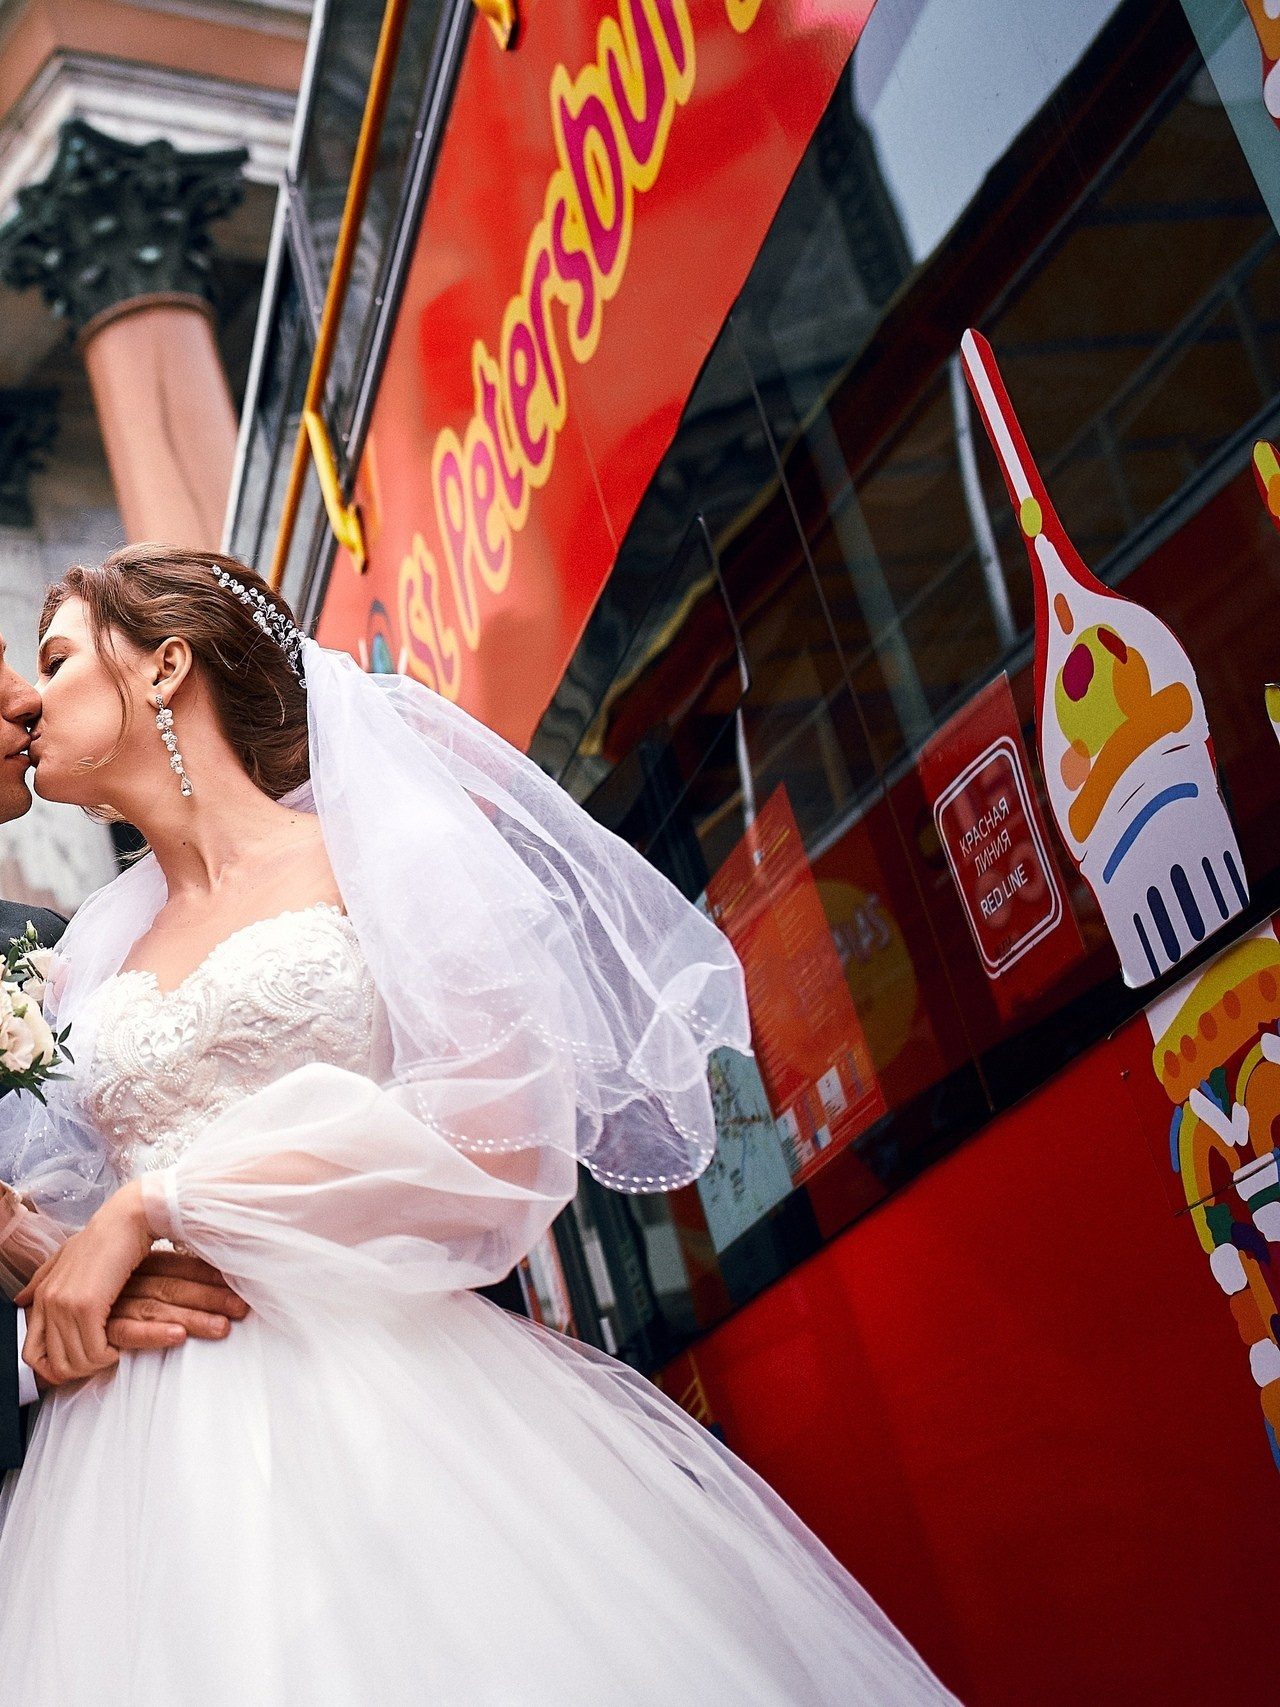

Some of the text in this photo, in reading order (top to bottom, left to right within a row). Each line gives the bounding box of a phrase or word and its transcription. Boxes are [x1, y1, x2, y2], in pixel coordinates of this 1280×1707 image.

[398, 533, 462, 702] St
[959, 796, 1010, 858] КРАСНАЯ
[974, 828, 1012, 877] ЛИНИЯ
[980, 863, 1029, 919] RED LINE
